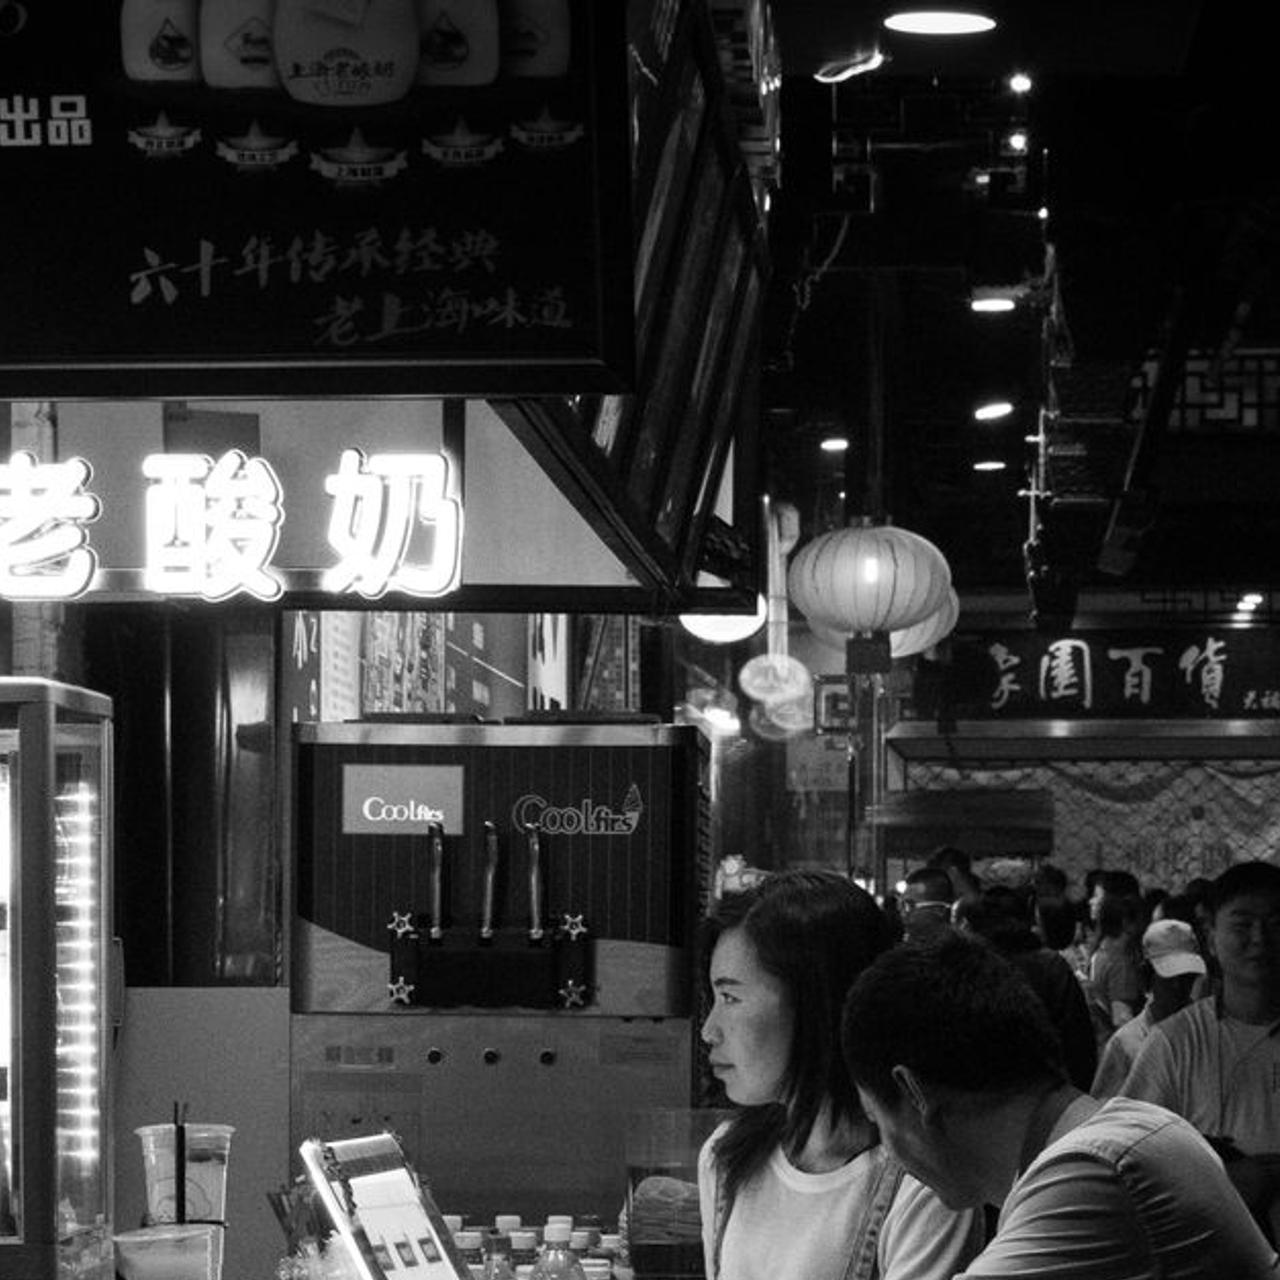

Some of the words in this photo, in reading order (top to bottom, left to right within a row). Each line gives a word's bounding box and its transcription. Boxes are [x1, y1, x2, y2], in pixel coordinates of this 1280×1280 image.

[128, 225, 503, 306] 六十年传承经典
[313, 282, 575, 347] 老上海味道
